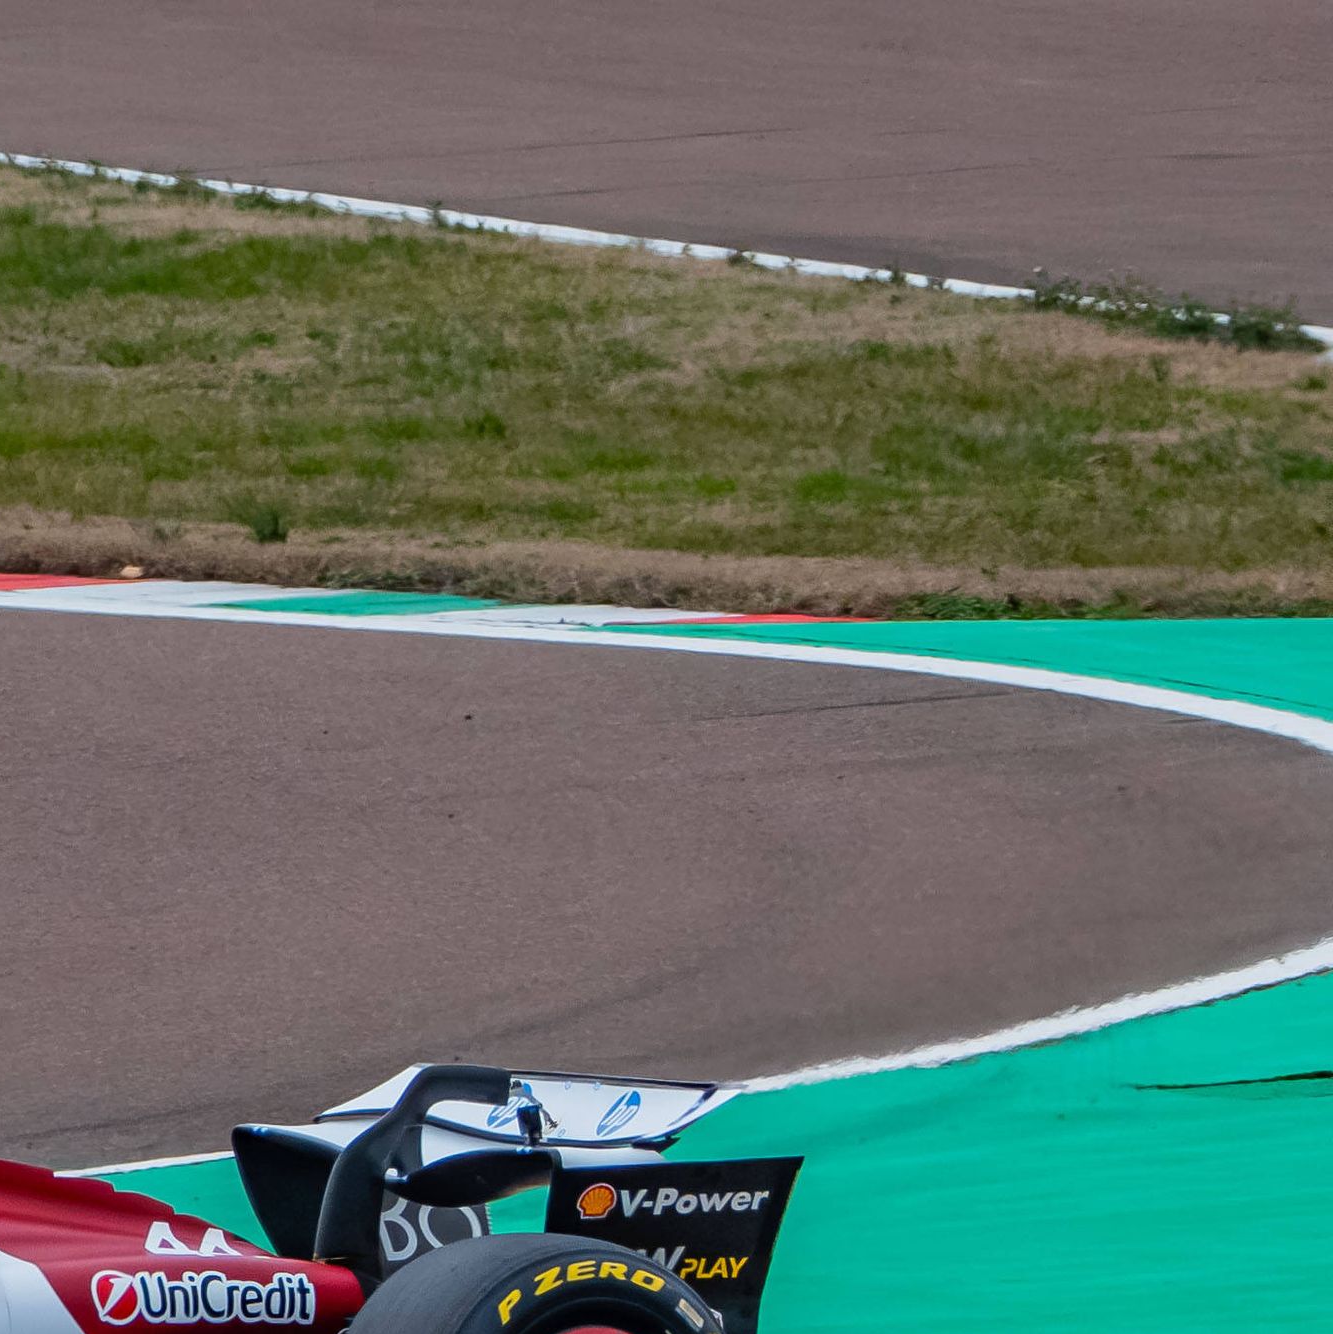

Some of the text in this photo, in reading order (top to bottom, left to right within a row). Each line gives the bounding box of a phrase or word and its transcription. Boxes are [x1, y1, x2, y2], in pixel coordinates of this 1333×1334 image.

[620, 1187, 770, 1218] V-Power
[679, 1256, 749, 1280] PLAY
[137, 1272, 313, 1322] UniCredit
[497, 1260, 666, 1326] P ZERO
